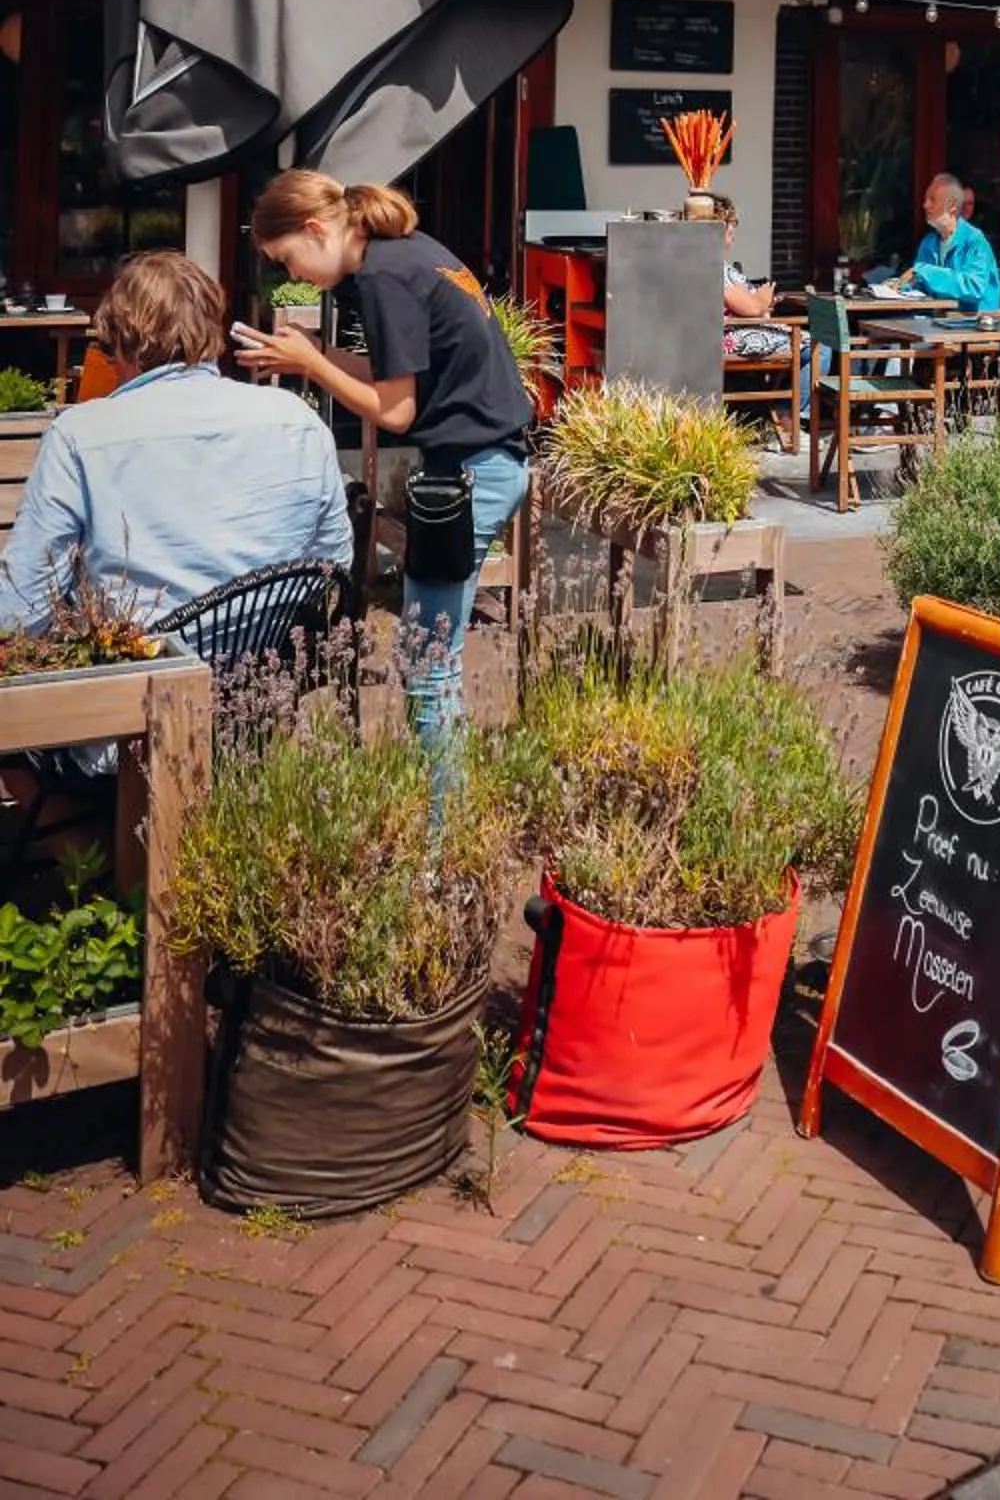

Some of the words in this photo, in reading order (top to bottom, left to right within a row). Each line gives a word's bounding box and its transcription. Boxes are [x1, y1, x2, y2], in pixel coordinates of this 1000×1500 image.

[965, 676, 993, 695] CAFÉ
[914, 794, 959, 865] Proef
[891, 850, 973, 940] Zeeuwse
